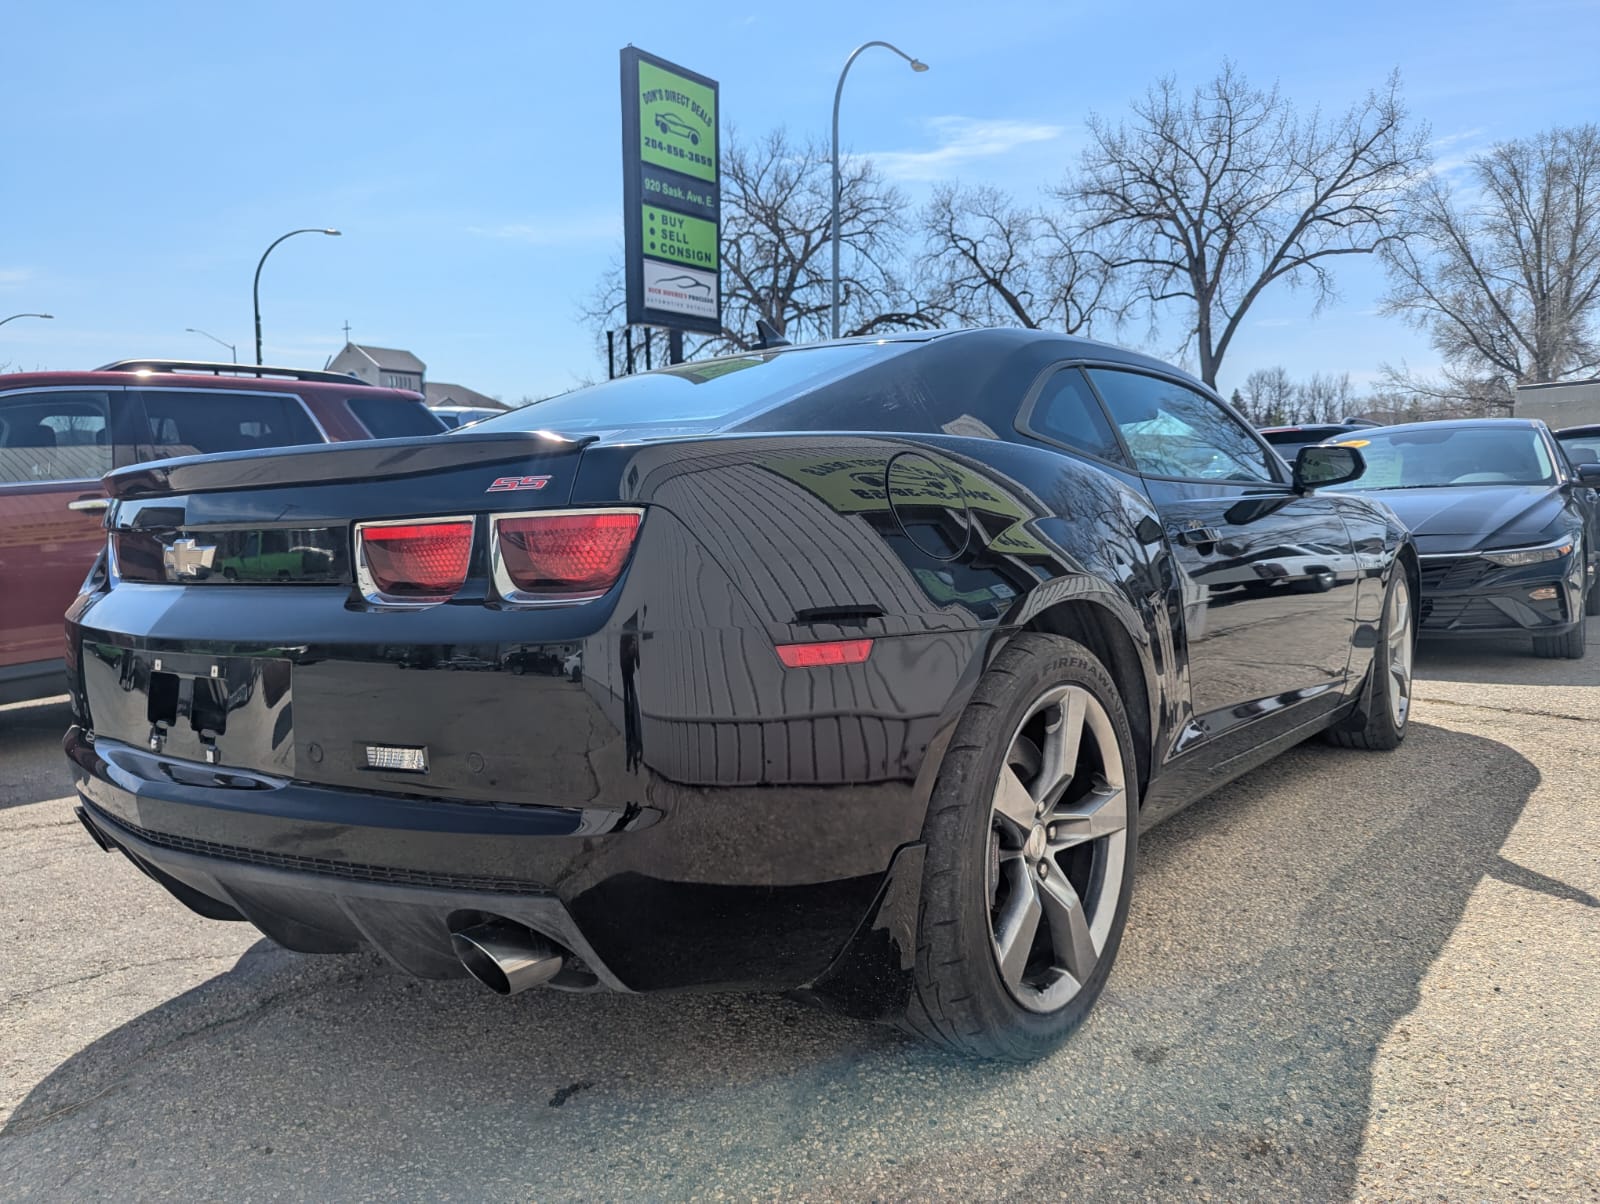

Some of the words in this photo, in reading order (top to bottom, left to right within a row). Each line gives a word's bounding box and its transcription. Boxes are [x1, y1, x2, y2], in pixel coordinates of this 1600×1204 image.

[643, 89, 663, 104] DON'S
[665, 90, 690, 108] DIRECT
[691, 100, 713, 127] DEALS
[645, 178, 660, 192] 920
[662, 183, 685, 199] Sask.
[687, 190, 704, 205] Ave.
[706, 195, 714, 207] E.
[661, 215, 684, 228] BUY
[661, 229, 689, 244] SELL
[660, 243, 712, 263] CONSIGN
[484, 475, 553, 493] SS
[1042, 657, 1117, 700] FIREHAWK
